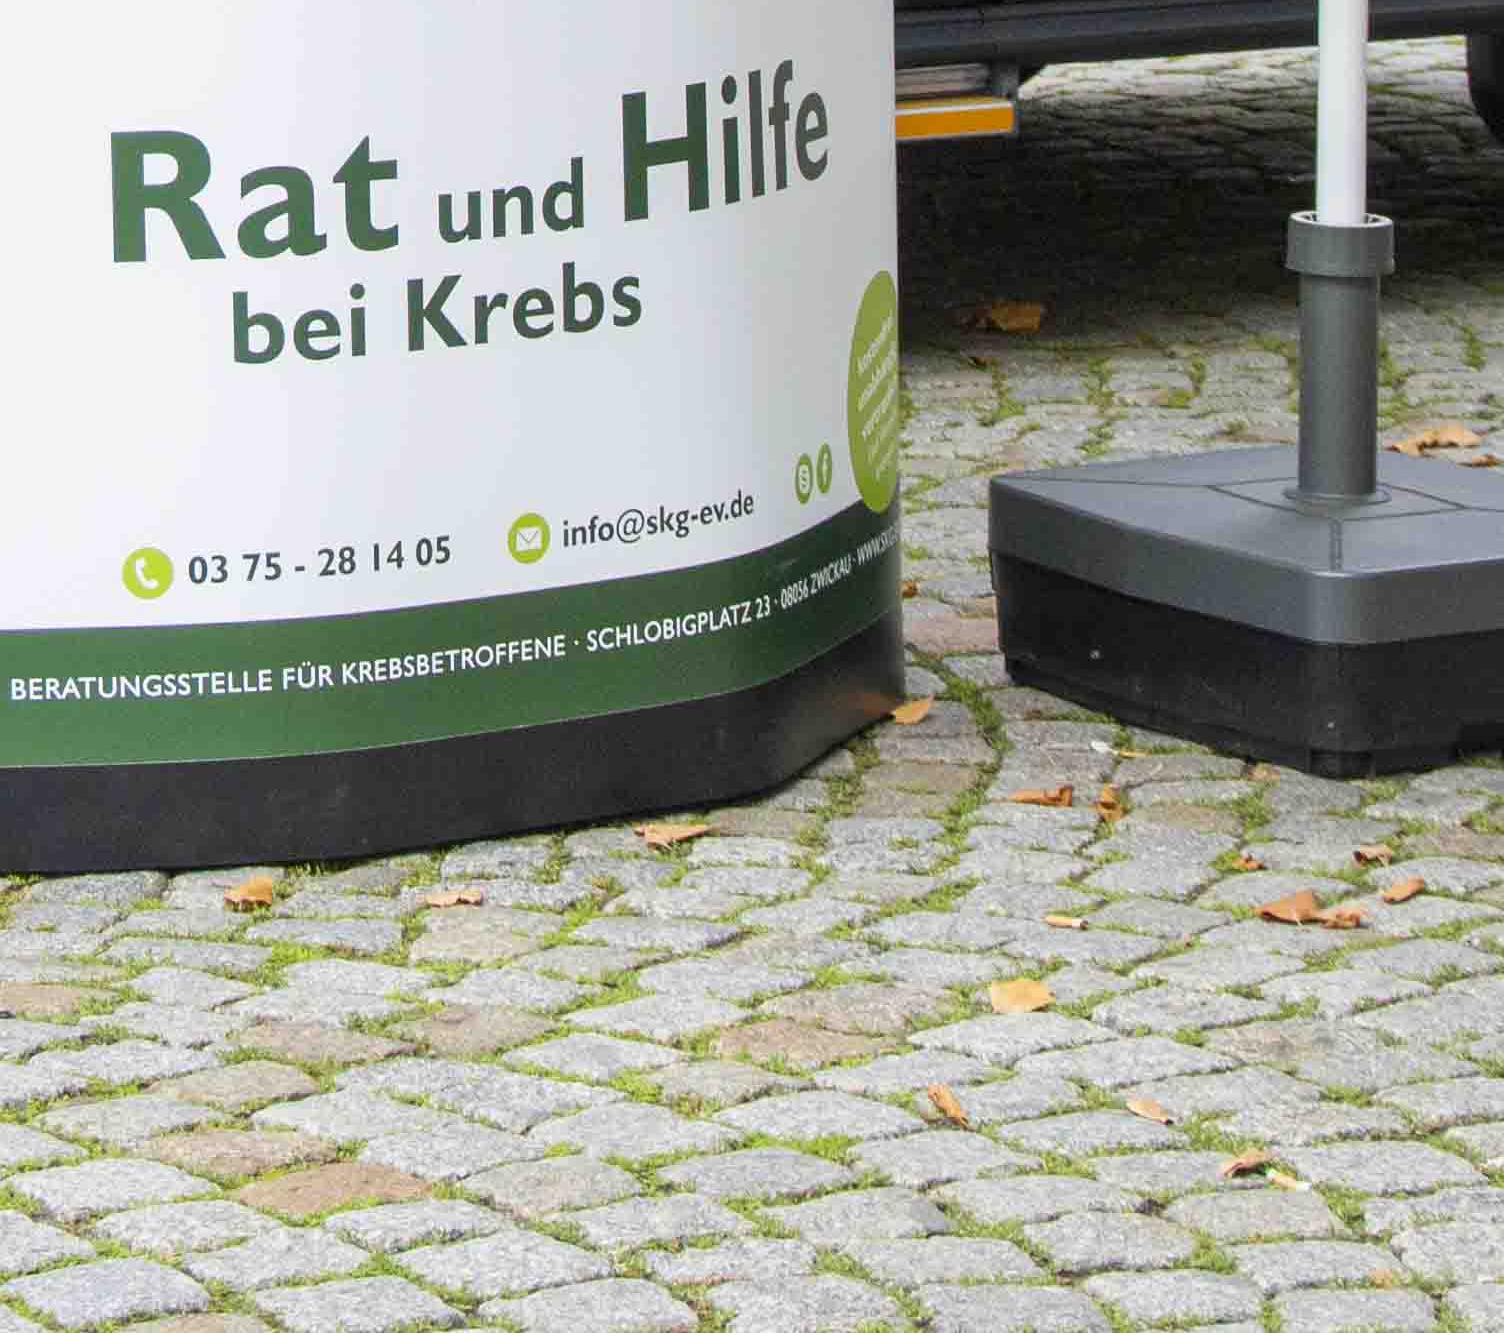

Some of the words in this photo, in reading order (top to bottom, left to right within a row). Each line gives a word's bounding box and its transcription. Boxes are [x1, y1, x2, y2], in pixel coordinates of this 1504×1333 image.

[109, 129, 400, 264] Rat
[437, 156, 585, 244] und
[622, 59, 830, 222] Hilfe
[232, 282, 366, 364] bei
[406, 261, 643, 352] Krebs
[188, 555, 230, 585] 03
[243, 552, 282, 582] 75
[318, 547, 356, 577] 28
[373, 542, 405, 572] 14
[415, 535, 452, 567] 05
[562, 490, 755, 548] info@skg-ev.de
[11, 668, 273, 701] BERATUNGSSTELLE
[283, 662, 332, 691] FÜR
[342, 635, 566, 686] KREBSBETROFFENE
[586, 602, 752, 653] SCHLOBIGPLATZ
[756, 596, 772, 622] 23
[780, 576, 809, 610] 08056
[810, 552, 852, 595] ZWICKAU
